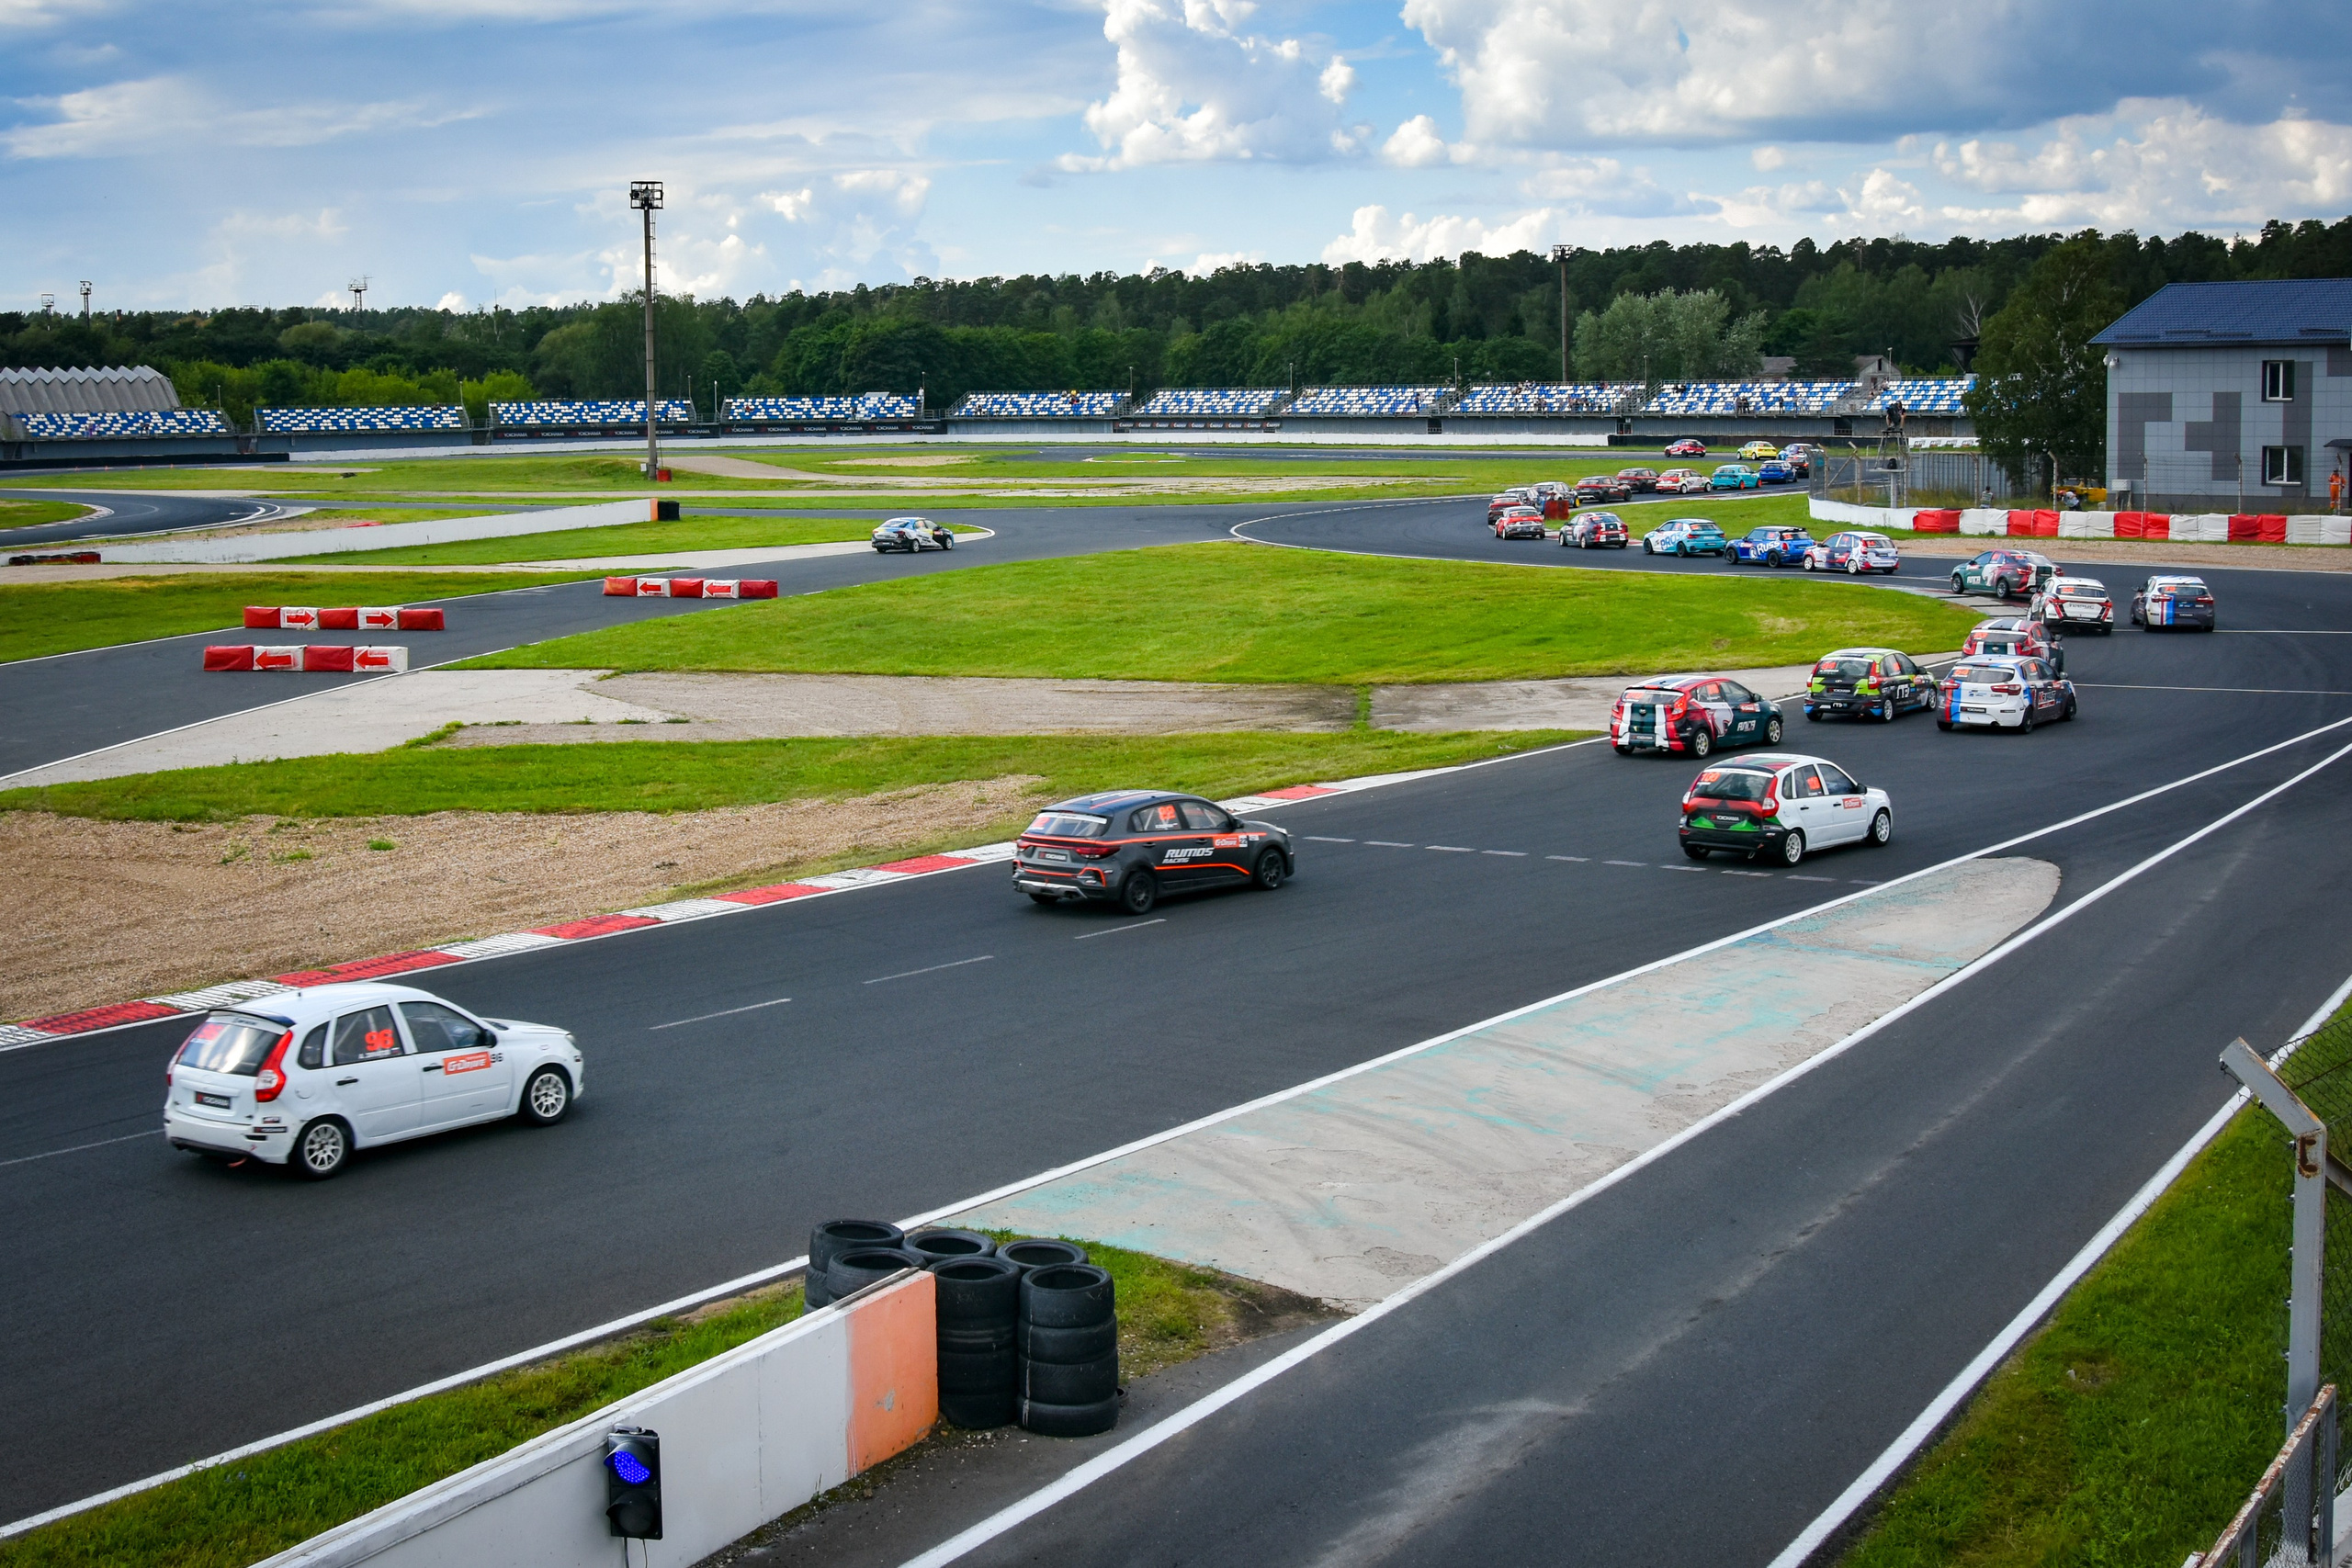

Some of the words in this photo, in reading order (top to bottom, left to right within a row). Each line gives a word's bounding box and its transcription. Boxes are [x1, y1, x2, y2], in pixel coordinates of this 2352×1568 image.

[1164, 847, 1216, 858] RUMOS
[365, 1029, 394, 1052] 96
[491, 1053, 503, 1063] 96
